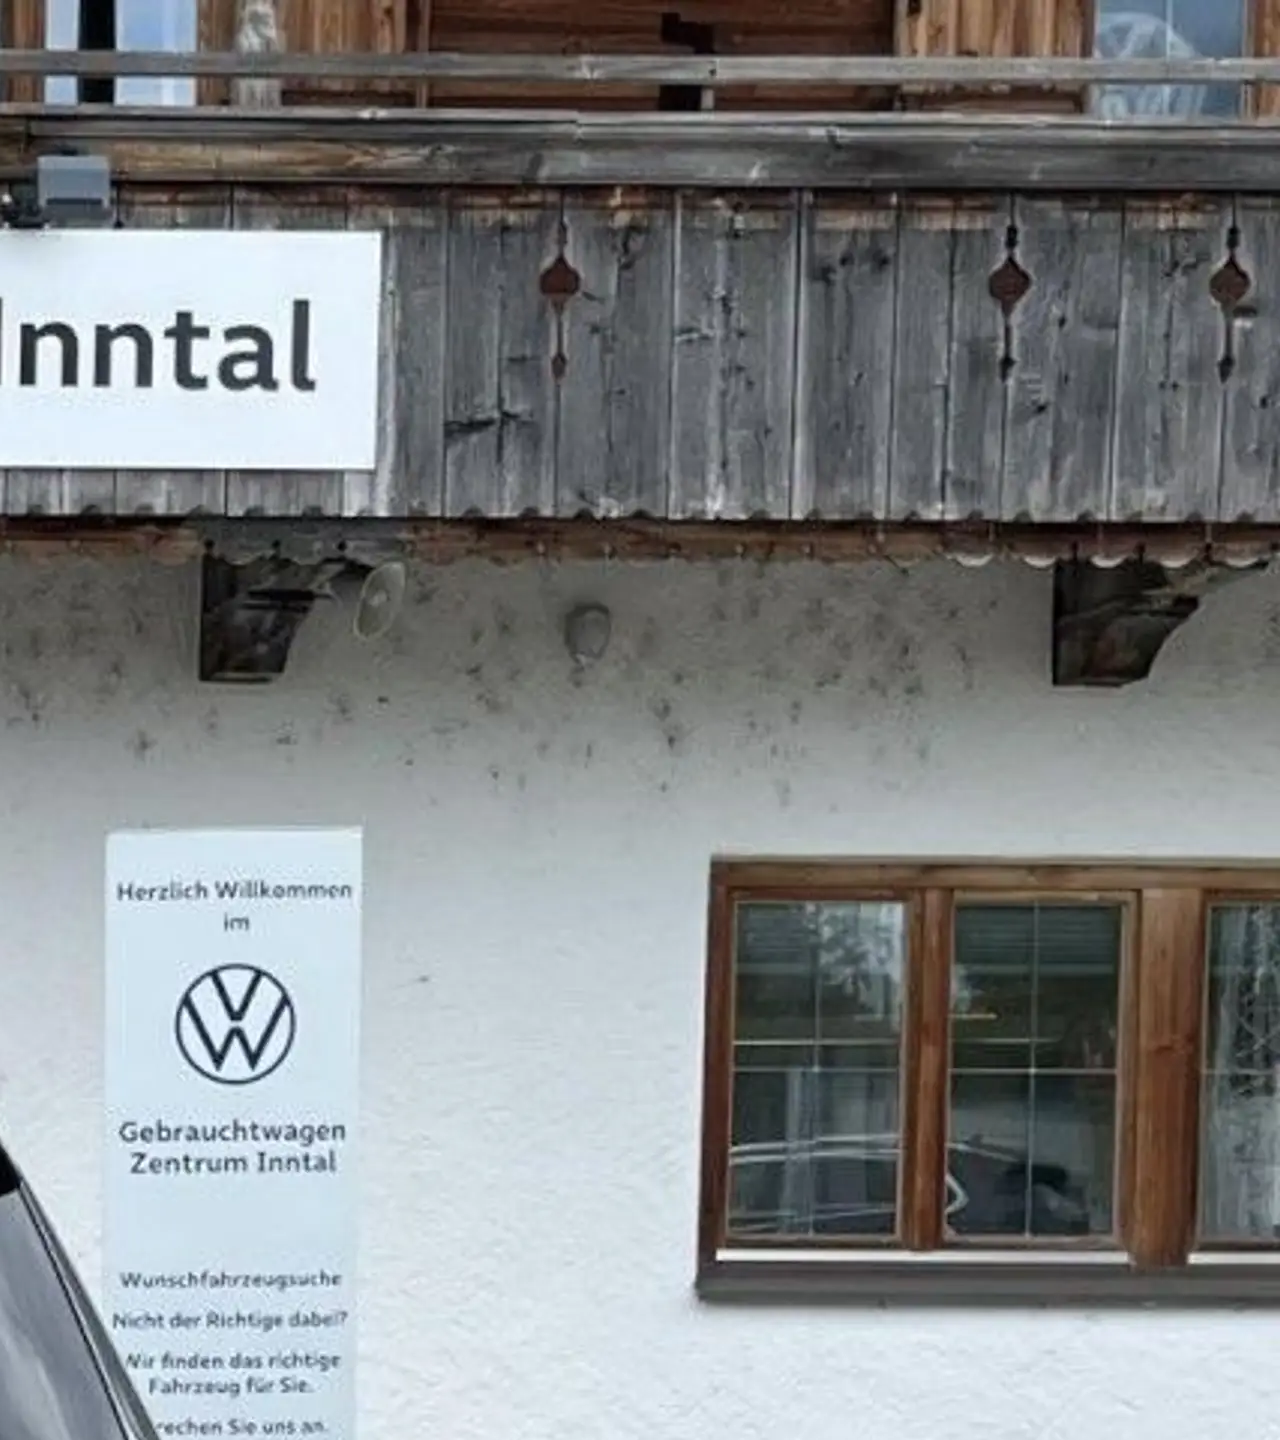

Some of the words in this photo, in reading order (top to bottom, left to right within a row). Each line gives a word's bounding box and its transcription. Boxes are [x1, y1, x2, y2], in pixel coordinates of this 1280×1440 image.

[116, 879, 209, 901] Herzlich
[214, 878, 353, 900] Willkommen
[223, 911, 251, 932] im
[117, 1118, 347, 1148] Gebrauchtwagen
[129, 1151, 249, 1175] Zentrum
[256, 1150, 338, 1174] Inntal
[120, 1270, 343, 1291] Wunschfahrzeugsuche
[112, 1312, 165, 1329] Nicht
[168, 1312, 202, 1329] der
[205, 1311, 284, 1332] Richtige
[288, 1310, 349, 1328] dabei?
[160, 1350, 225, 1369] finden
[228, 1352, 264, 1369] das
[268, 1352, 342, 1372] richtige
[148, 1377, 241, 1399] Fahrzeug
[245, 1376, 275, 1394] für
[227, 1417, 258, 1436] Sie
[261, 1419, 297, 1435] uns
